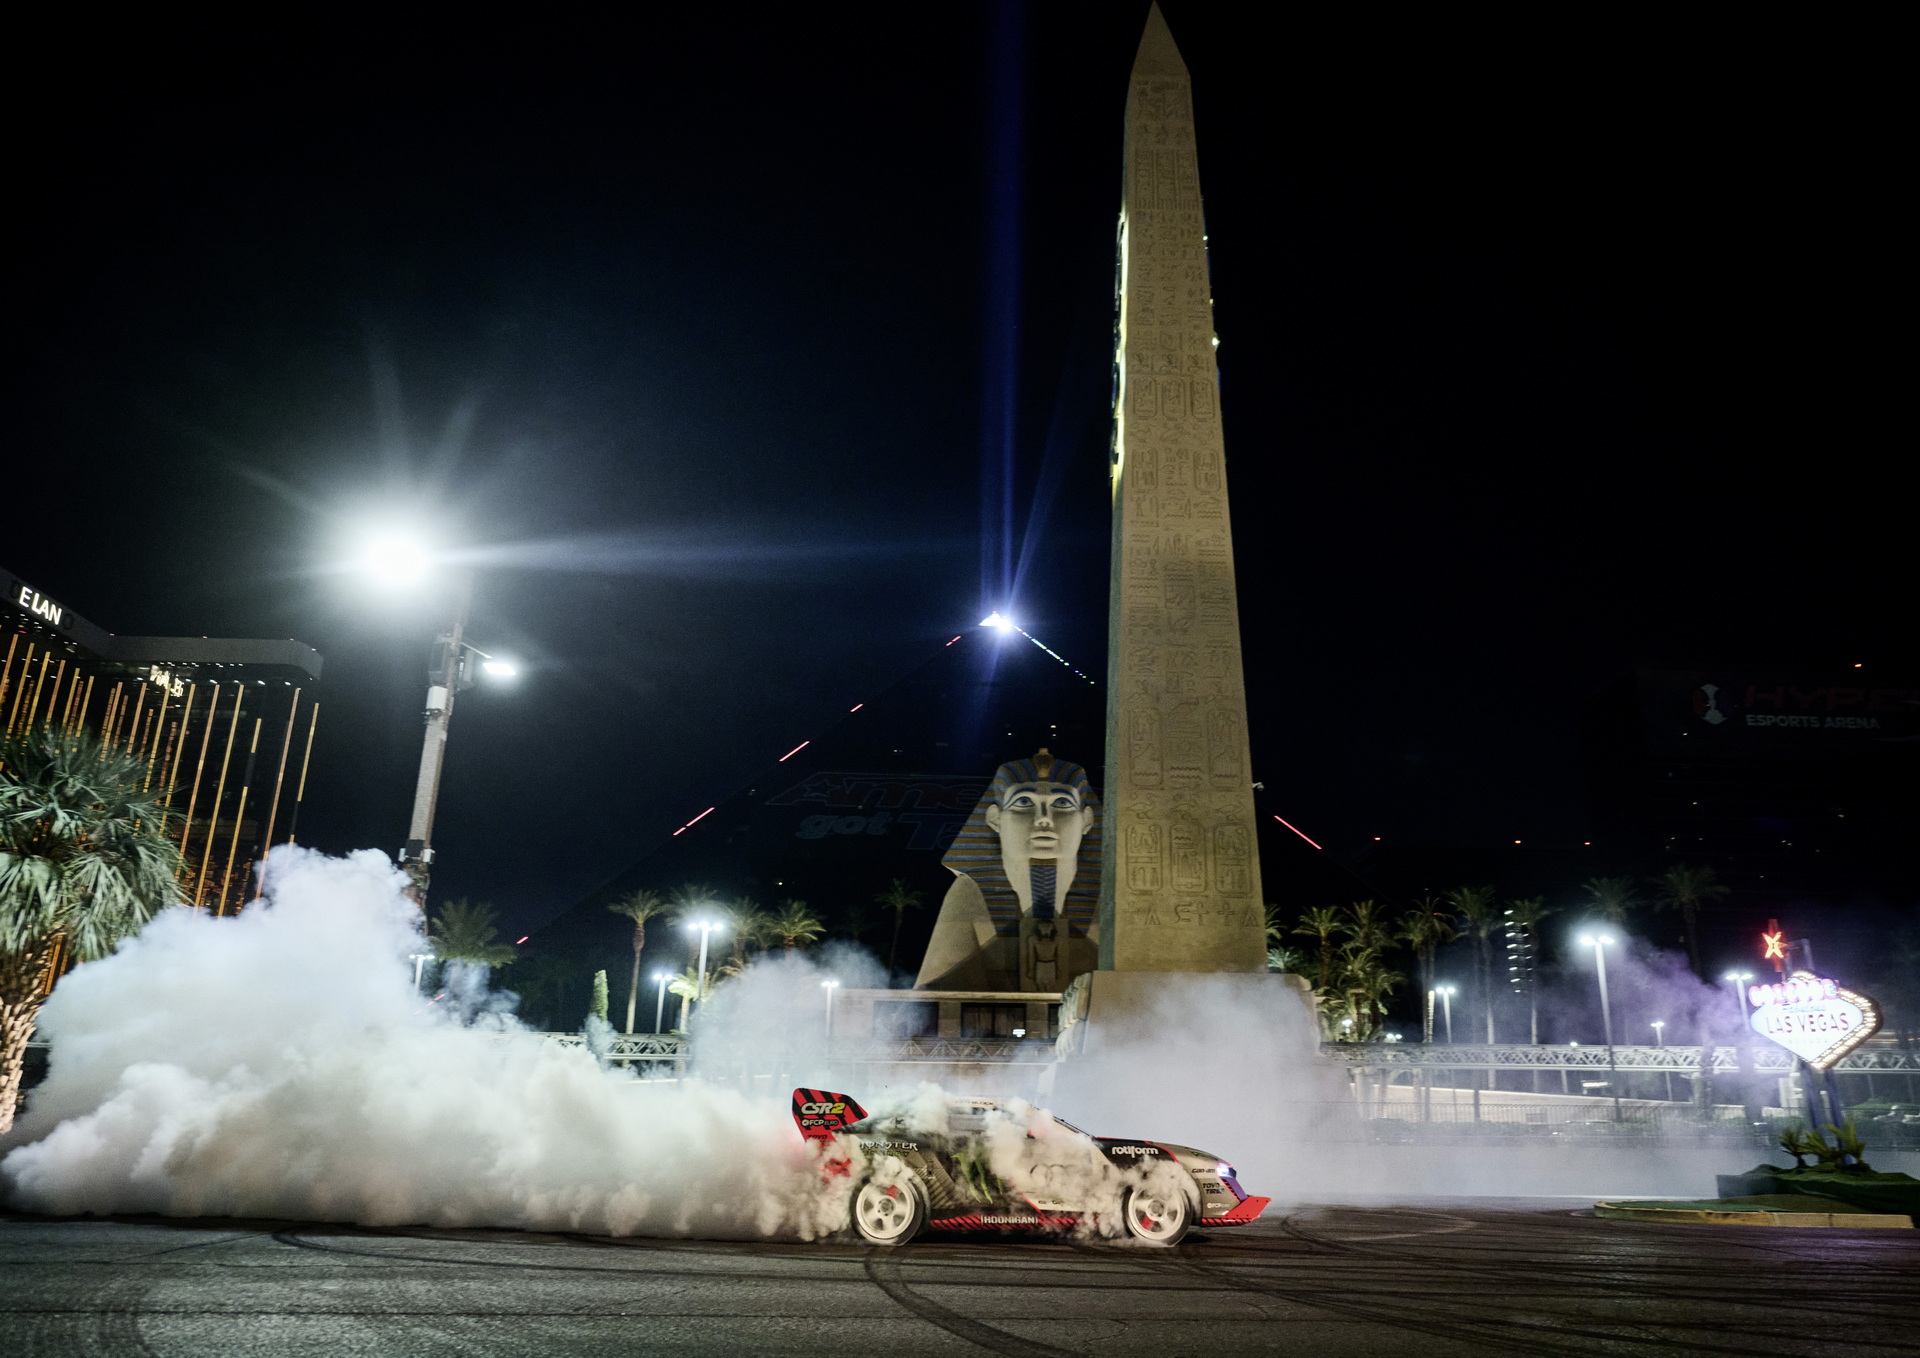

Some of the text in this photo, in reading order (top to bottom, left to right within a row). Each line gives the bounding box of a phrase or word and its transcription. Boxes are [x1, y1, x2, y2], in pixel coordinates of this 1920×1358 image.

[1744, 684, 1920, 712] HYPE
[1745, 714, 1881, 729] ESPORTS ARENA
[1766, 1012, 1849, 1034] LAS VEGAS
[801, 1102, 846, 1114] CSR2
[1112, 1146, 1159, 1158] rotiform
